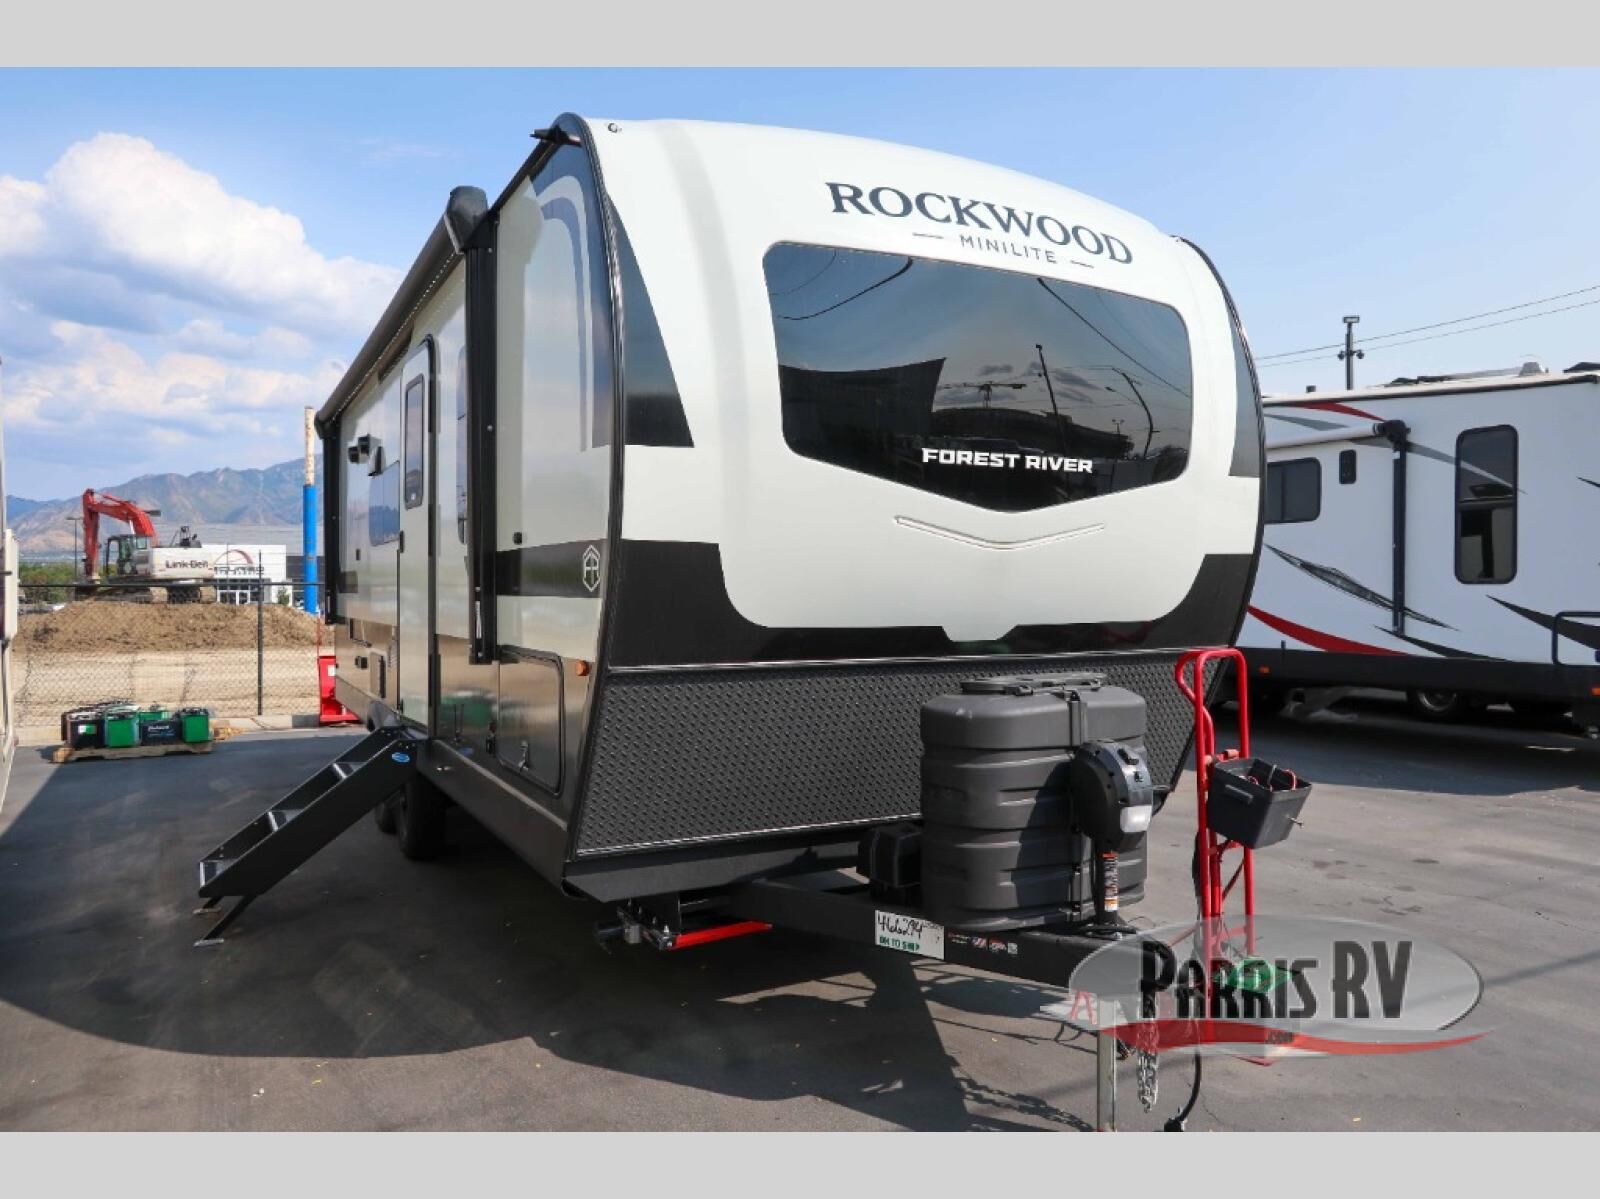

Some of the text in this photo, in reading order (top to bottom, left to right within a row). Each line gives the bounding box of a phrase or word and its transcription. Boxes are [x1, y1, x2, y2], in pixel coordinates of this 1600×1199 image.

[825, 182, 1133, 264] ROCKWOOD
[959, 234, 1058, 263] MINILITE
[921, 447, 1093, 473] FOREST RIVER
